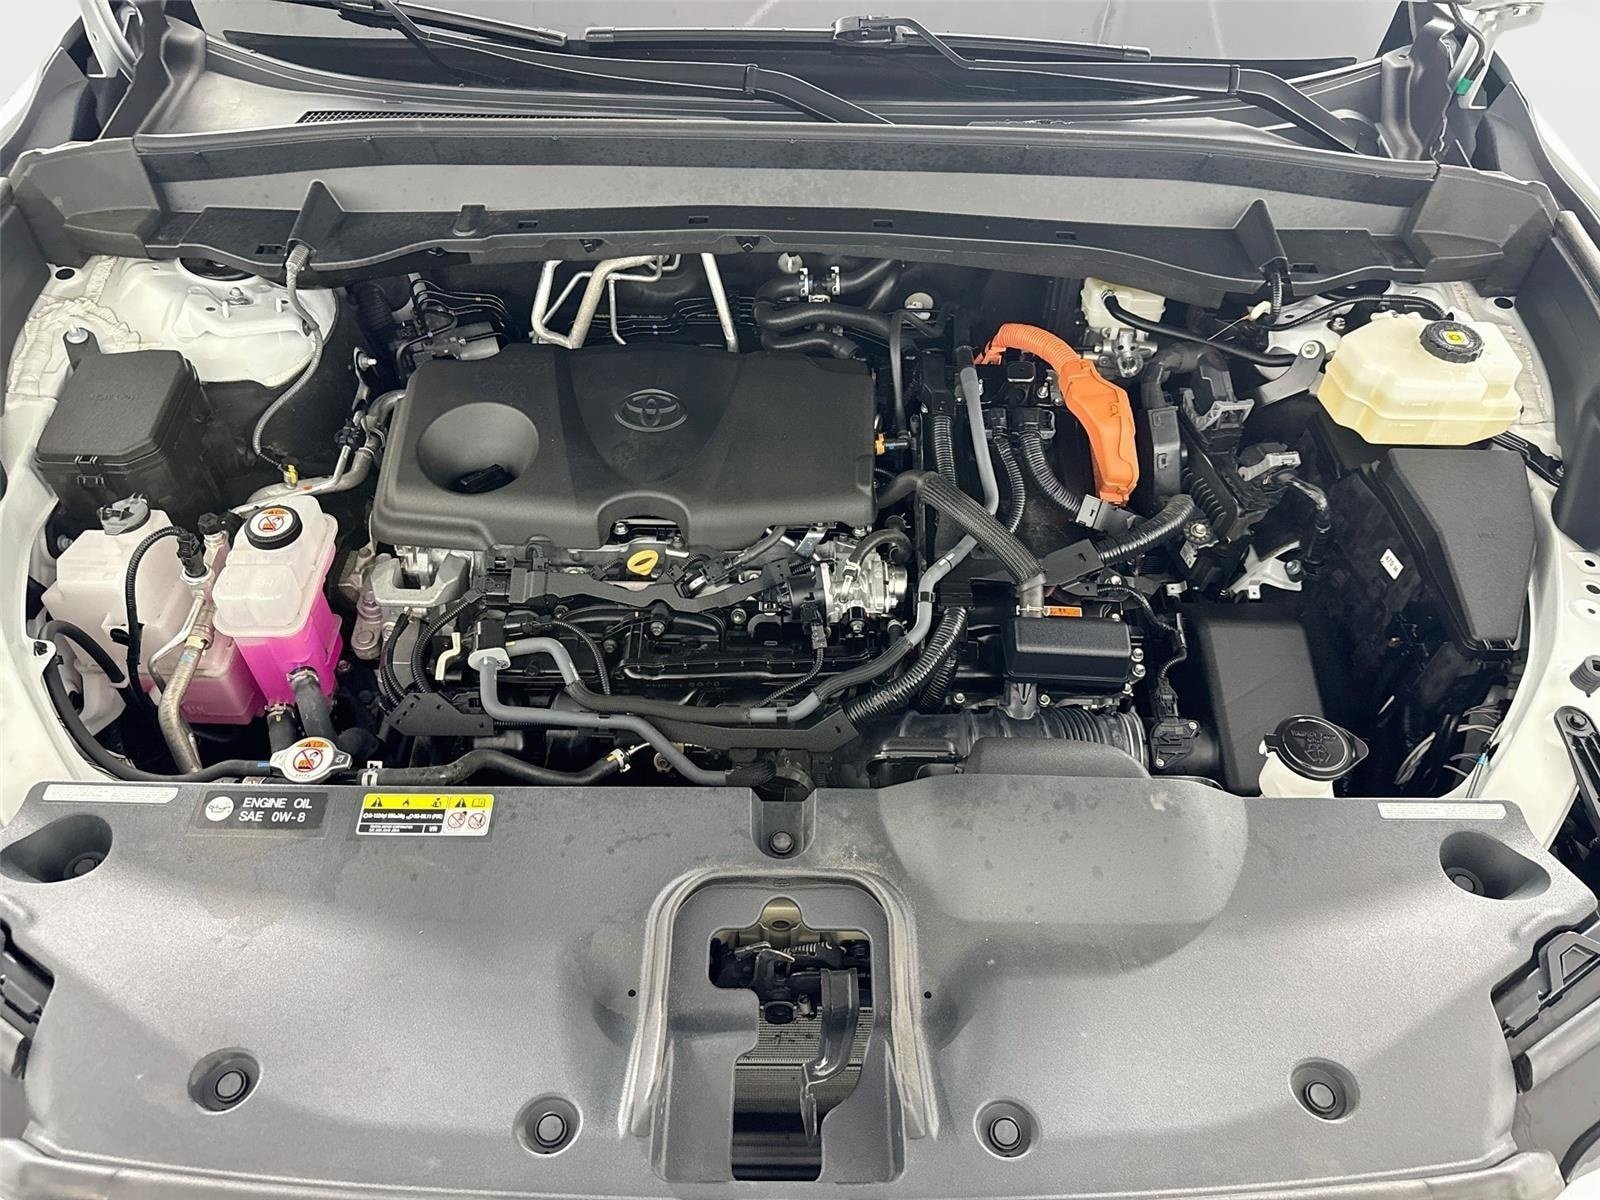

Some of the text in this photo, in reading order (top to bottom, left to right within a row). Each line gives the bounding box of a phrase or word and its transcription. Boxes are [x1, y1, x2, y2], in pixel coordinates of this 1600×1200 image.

[243, 797, 313, 809] ENGINE OIL
[238, 811, 306, 823] SAE 0W-8
